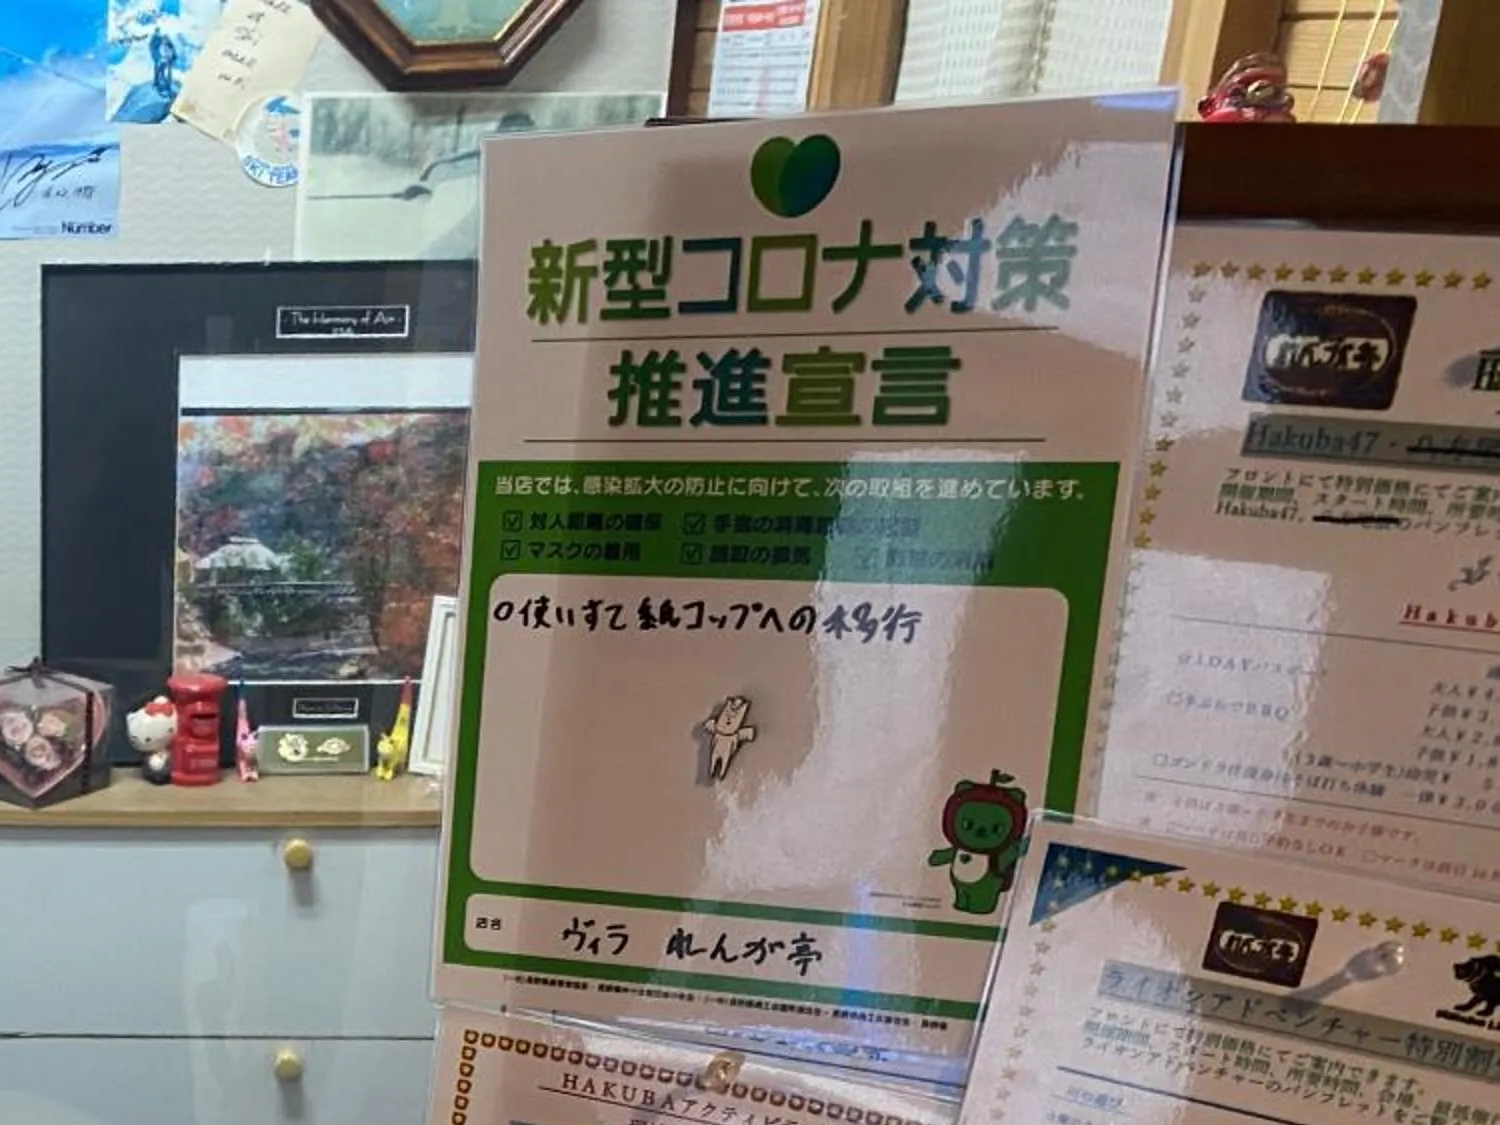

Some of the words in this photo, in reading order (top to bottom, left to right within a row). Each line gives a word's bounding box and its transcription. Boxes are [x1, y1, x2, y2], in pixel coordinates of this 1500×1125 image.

[60, 220, 113, 236] Number
[525, 213, 1079, 326] 新型コロナ対策
[607, 345, 963, 430] 推進宣言
[1104, 969, 1500, 1076] ライオンアドベンチャー特別割
